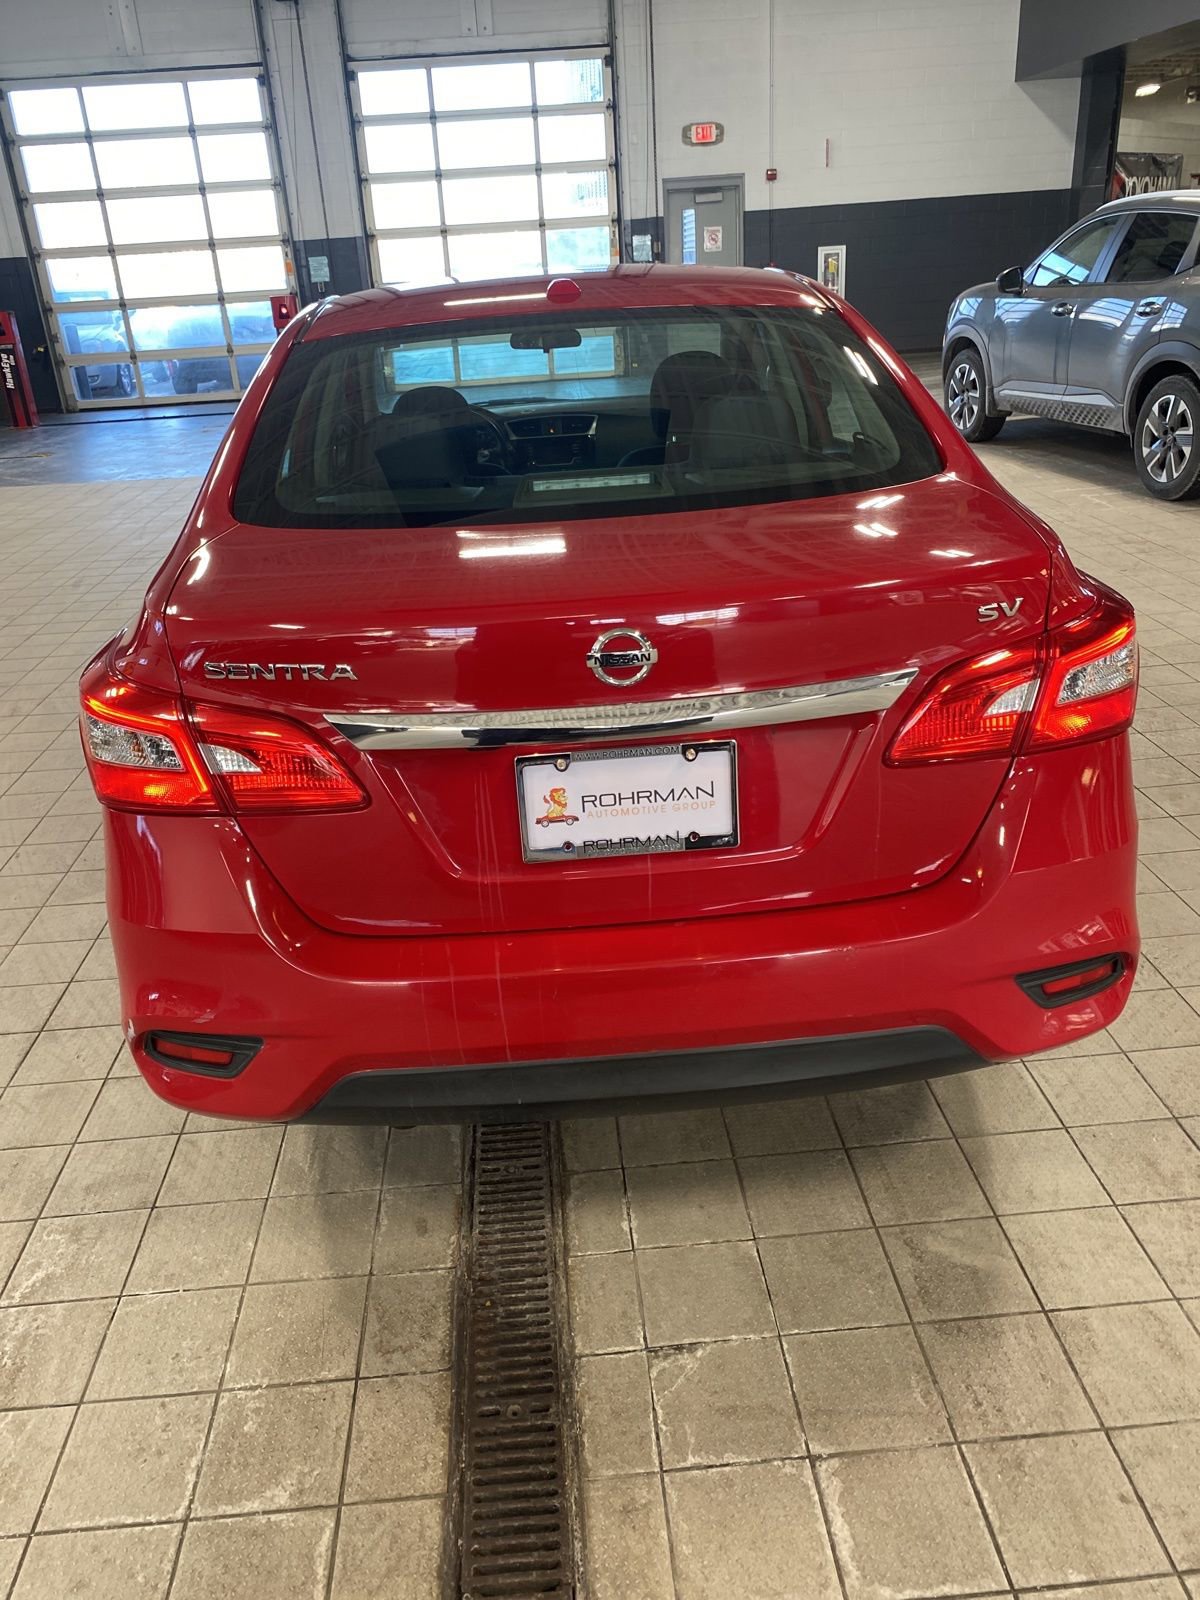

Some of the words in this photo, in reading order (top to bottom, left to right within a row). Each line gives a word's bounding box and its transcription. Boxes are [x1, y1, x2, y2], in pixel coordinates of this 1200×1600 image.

[695, 125, 713, 141] EXIT
[1, 353, 15, 389] HawkEye
[977, 597, 1024, 623] SV
[594, 652, 651, 668] NISSAN
[203, 661, 358, 681] SENTRA
[581, 780, 715, 813] ROHRMAN
[587, 804, 667, 819] AUTOMOTIVE
[672, 800, 716, 812] GROUP
[583, 830, 680, 853] ROHRMAN
